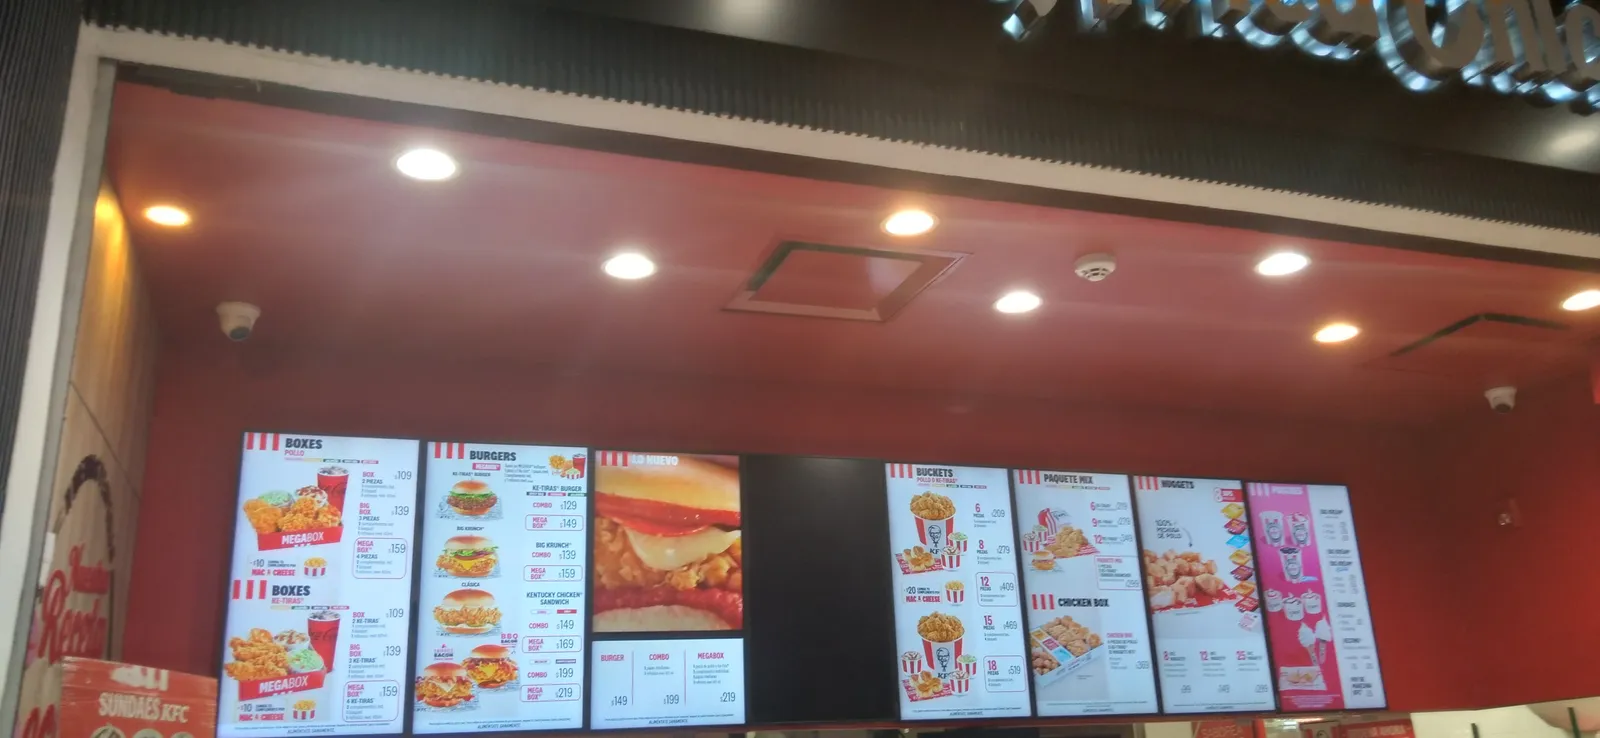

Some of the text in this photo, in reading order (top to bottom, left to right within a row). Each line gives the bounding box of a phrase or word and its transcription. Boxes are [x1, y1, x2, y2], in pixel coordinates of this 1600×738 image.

[284, 438, 323, 450] BOXES
[470, 450, 516, 462] BURGERS
[646, 454, 679, 466] NUEVO
[394, 471, 412, 480] $109
[916, 468, 954, 478] BUCKETS
[1044, 474, 1094, 484] PAQUETE MIX
[1161, 480, 1195, 489] NUGGETS
[560, 500, 578, 510] $129
[975, 503, 980, 512] 6
[1090, 502, 1096, 511] 6
[391, 506, 409, 516] $139
[991, 508, 1006, 518] $209
[560, 518, 577, 528] $149
[1092, 518, 1098, 528] 9
[281, 532, 324, 545] MEGABOX
[1094, 534, 1103, 544] 12
[388, 544, 406, 554] $159
[978, 540, 984, 550] 8
[996, 545, 1010, 554] $279
[559, 550, 576, 560] $139
[558, 568, 576, 578] $159
[980, 576, 990, 586] 12
[272, 585, 310, 596] BOXES
[1058, 598, 1110, 608] CHICKEN BOX
[386, 608, 404, 618] $109
[556, 620, 574, 630] $149
[984, 616, 993, 626] 15
[556, 638, 574, 649] $169
[384, 646, 401, 656] $139
[988, 660, 998, 670] 18
[1008, 666, 1021, 674] $519
[556, 668, 574, 678] $199
[259, 676, 309, 693] MEGABOX
[379, 686, 398, 697] $159
[556, 688, 573, 698] $219
[611, 692, 736, 706] $149 $199 $219
[98, 692, 190, 723] SUNDAES KFC
